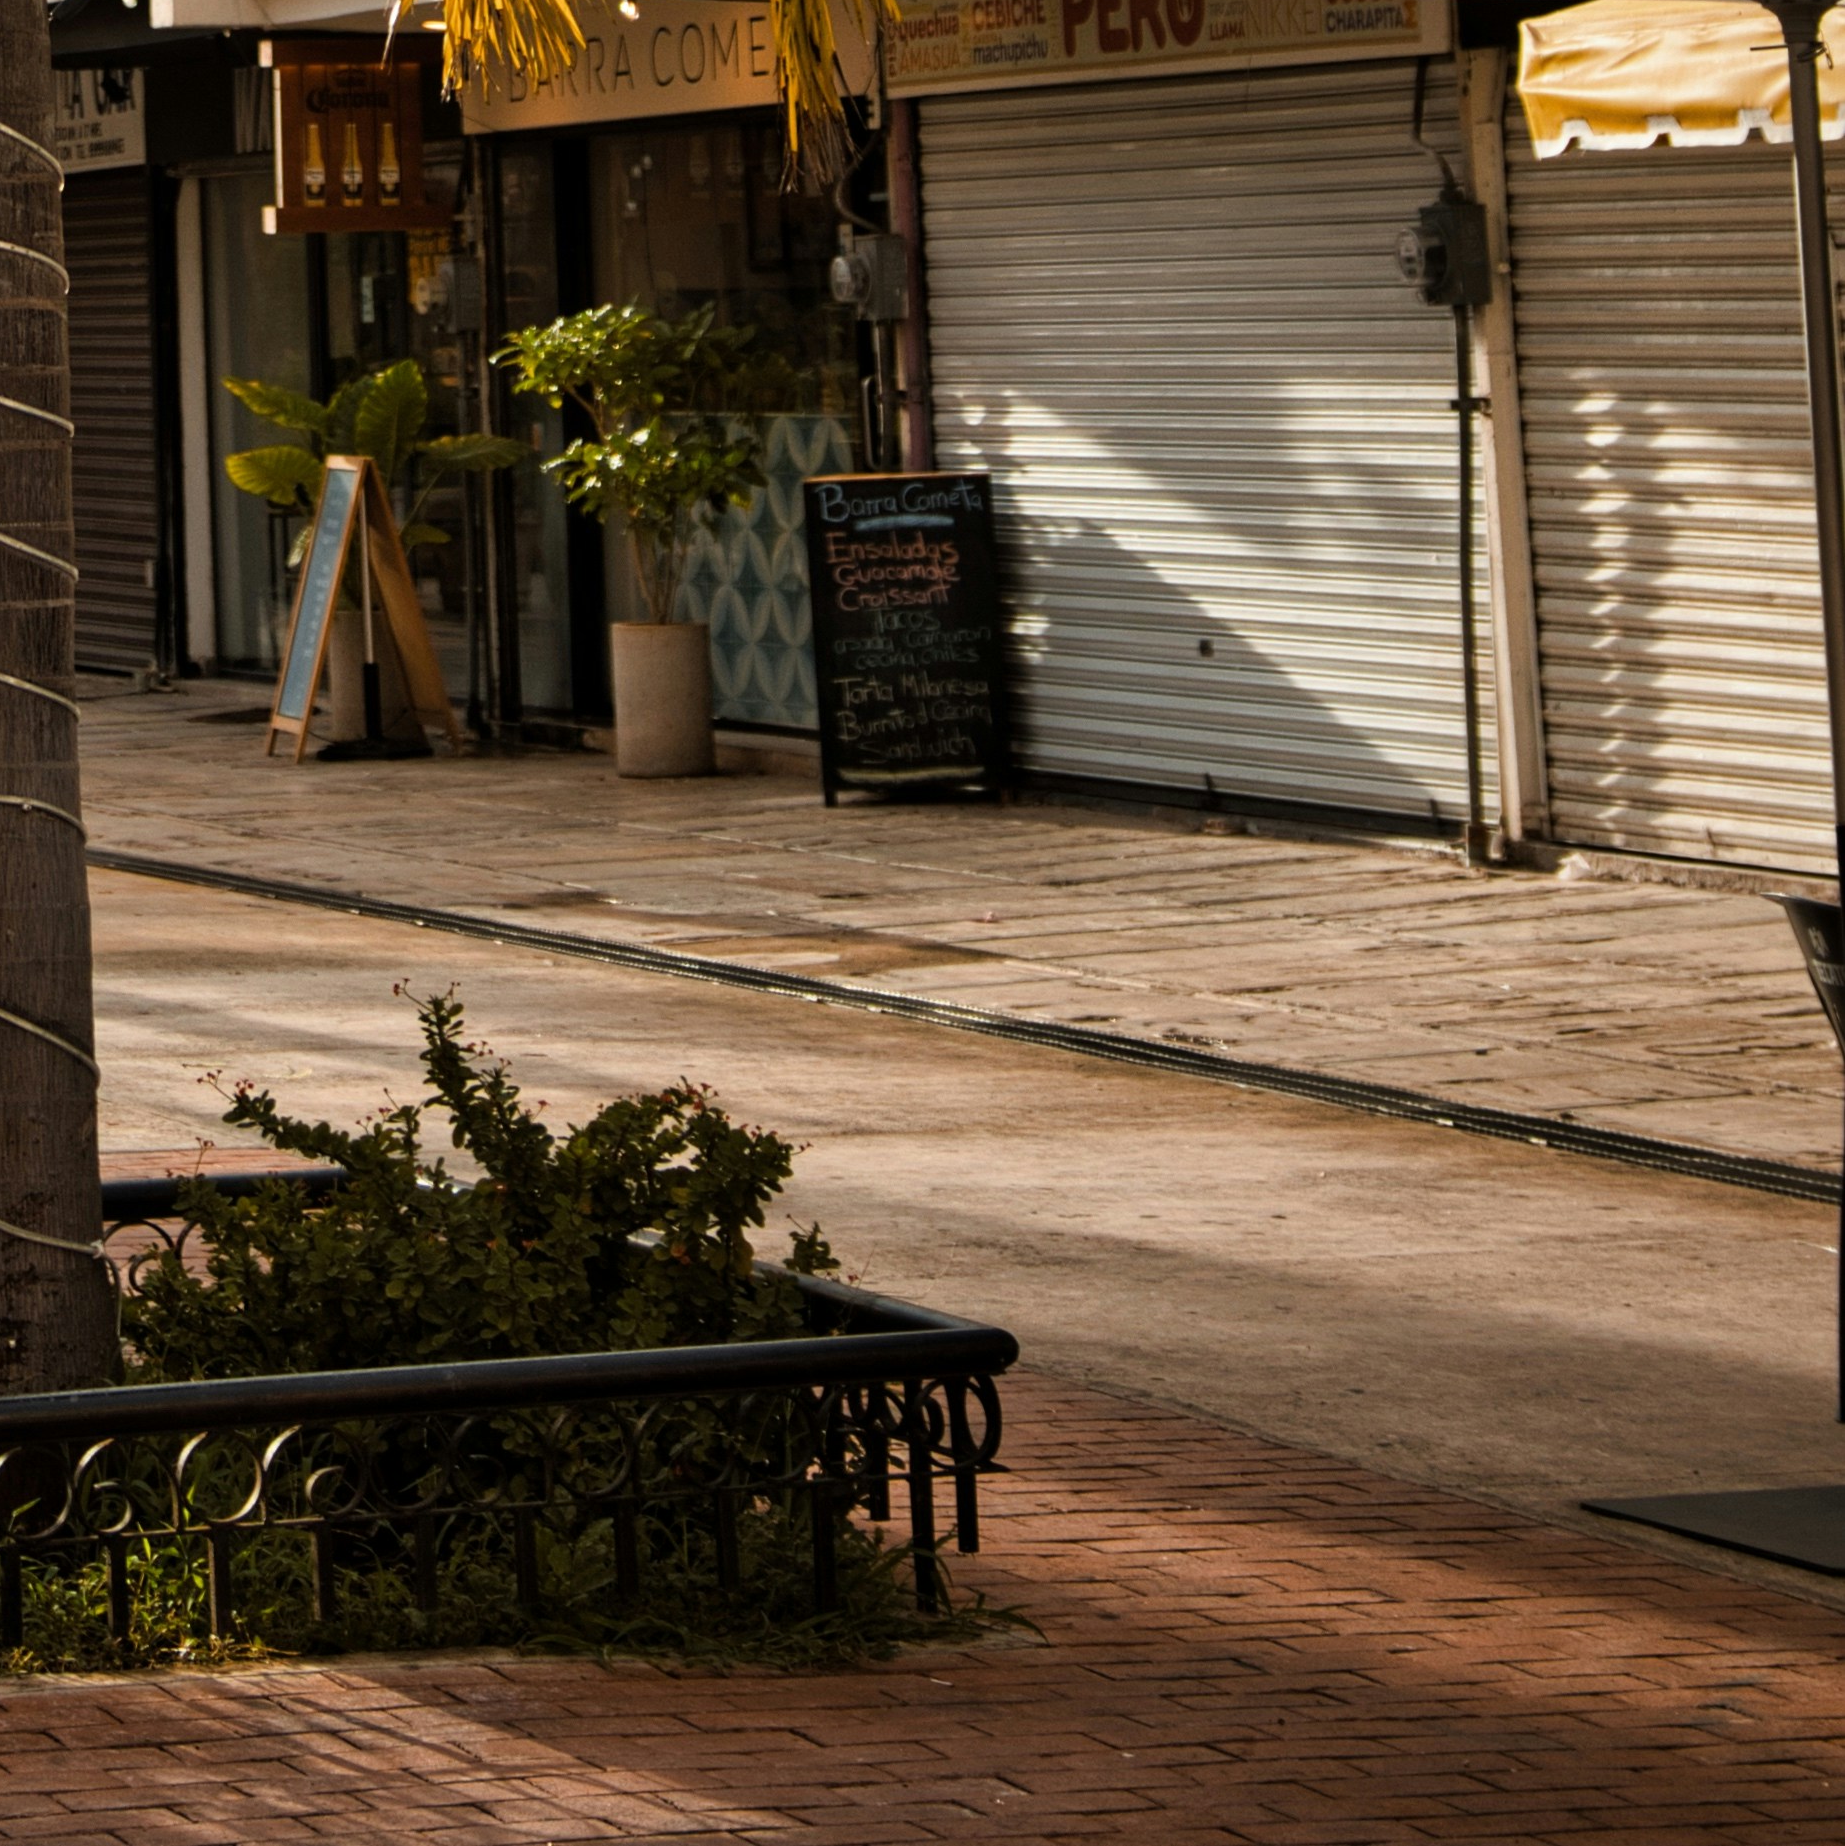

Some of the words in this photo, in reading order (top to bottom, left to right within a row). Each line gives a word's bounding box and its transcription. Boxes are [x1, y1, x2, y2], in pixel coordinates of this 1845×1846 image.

[898, 11, 960, 46] quechua
[1325, 7, 1404, 34] CHARAPITA
[649, 15, 776, 86] COME
[973, 32, 1049, 65] machupichu
[814, 483, 898, 523] Barra
[902, 477, 983, 513] Cometa
[825, 530, 960, 565] Ensaladas
[833, 558, 961, 586] Guacamole
[837, 579, 951, 612] Croissant
[863, 608, 942, 635] Tacos
[831, 675, 894, 708] Torta
